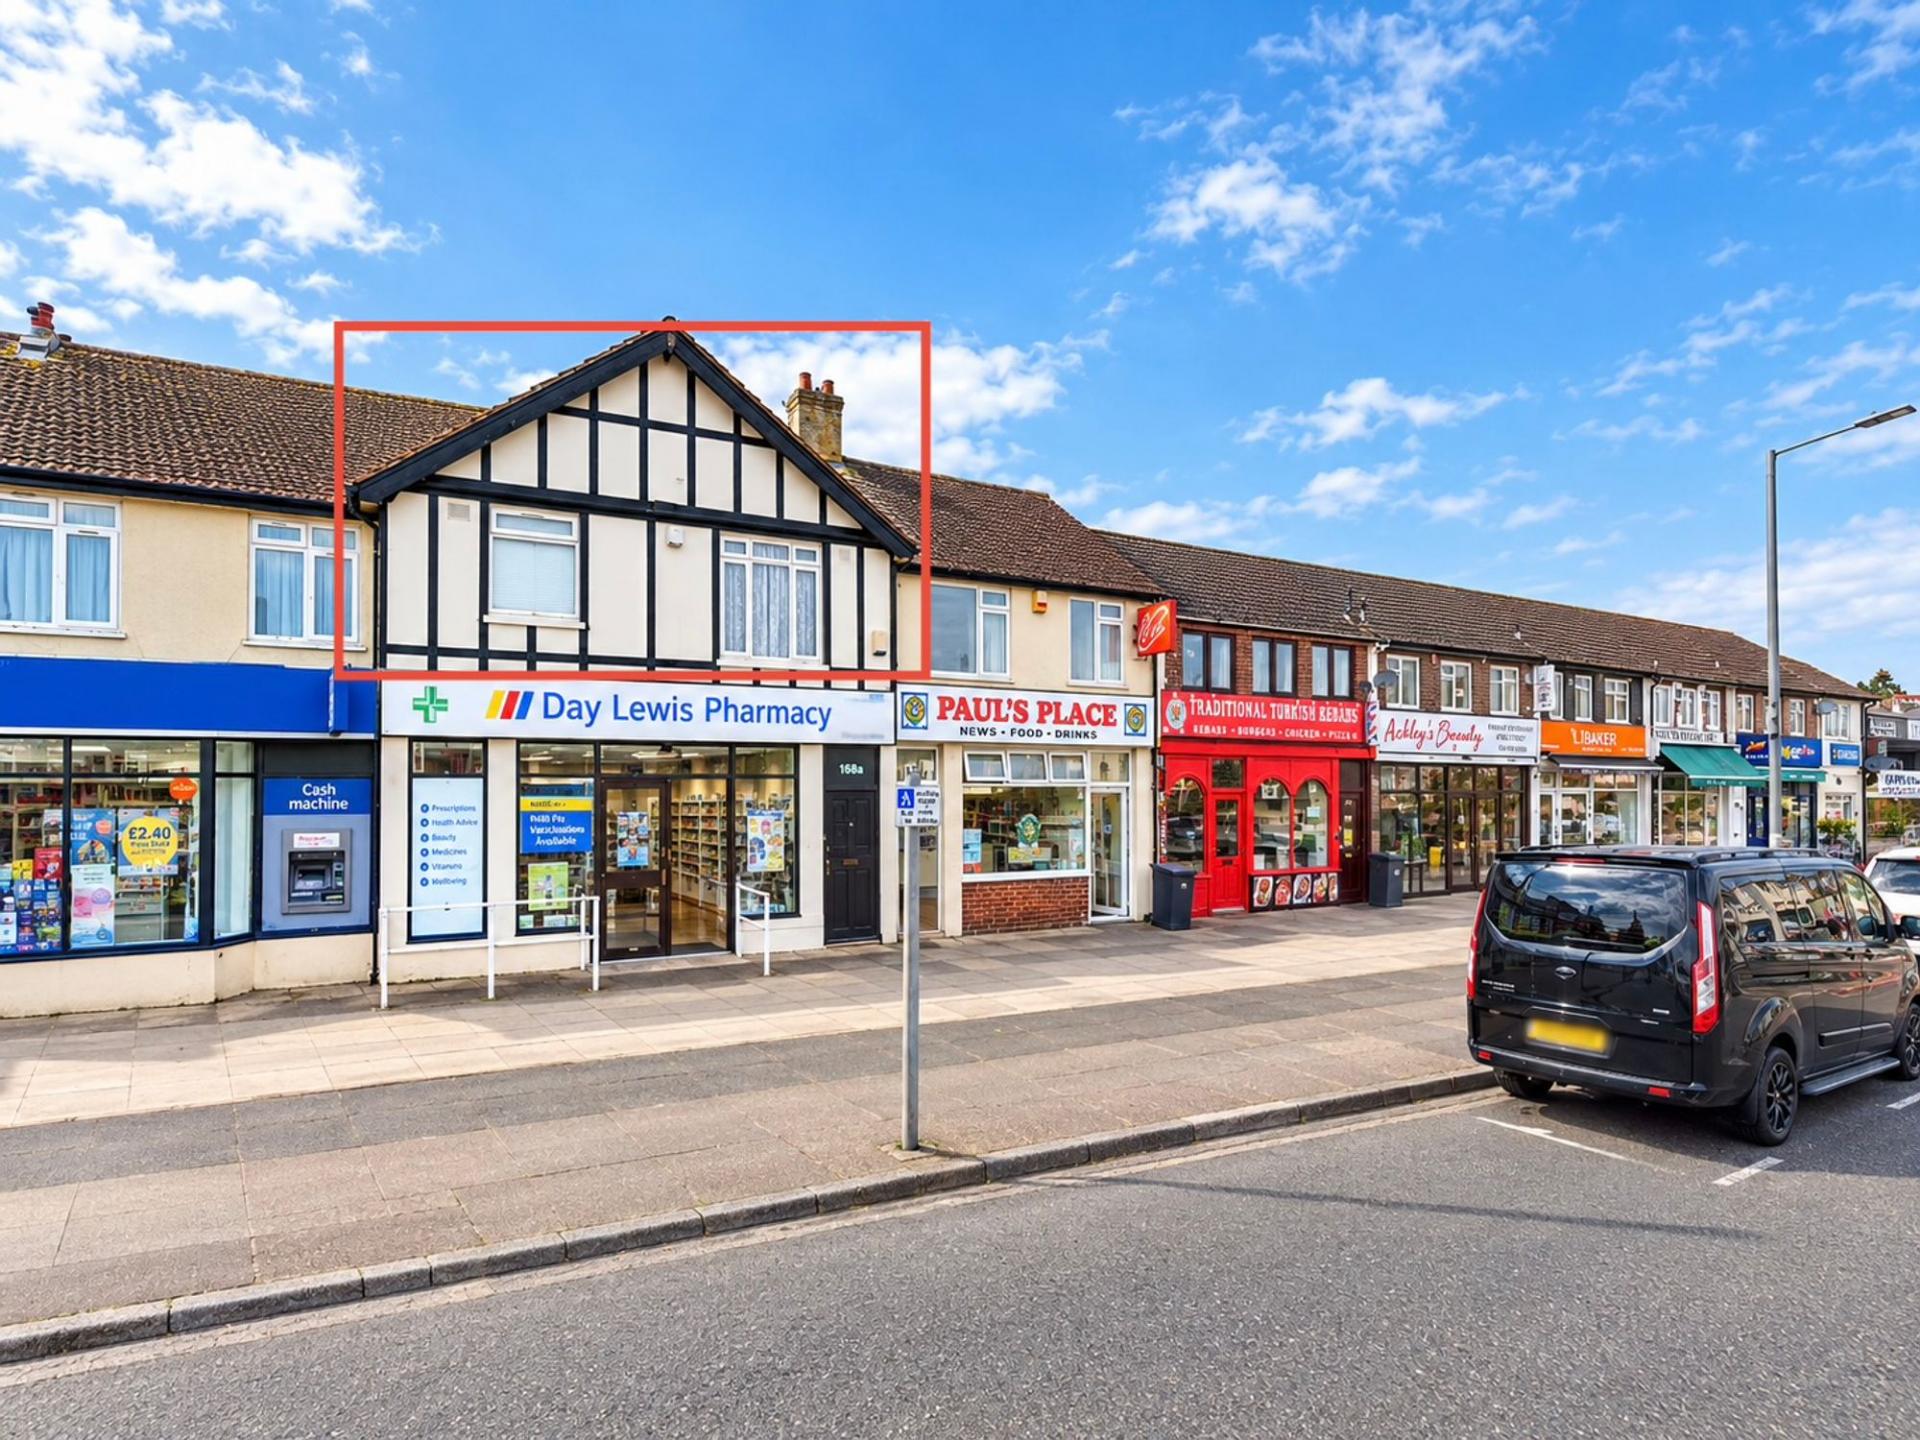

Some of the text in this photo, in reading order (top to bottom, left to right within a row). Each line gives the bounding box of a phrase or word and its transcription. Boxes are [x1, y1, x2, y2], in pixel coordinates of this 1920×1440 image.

[543, 691, 832, 732] Day Lewis Pharmacy
[936, 695, 1118, 728] PAUL'S PLACE
[1189, 697, 1268, 720] TRADITIONAL
[959, 726, 1098, 740] NEWS FOOD DRINKS
[302, 783, 336, 796] Cash
[289, 797, 349, 810] machine
[129, 826, 171, 840] £2.40
[431, 848, 467, 856] Medicines
